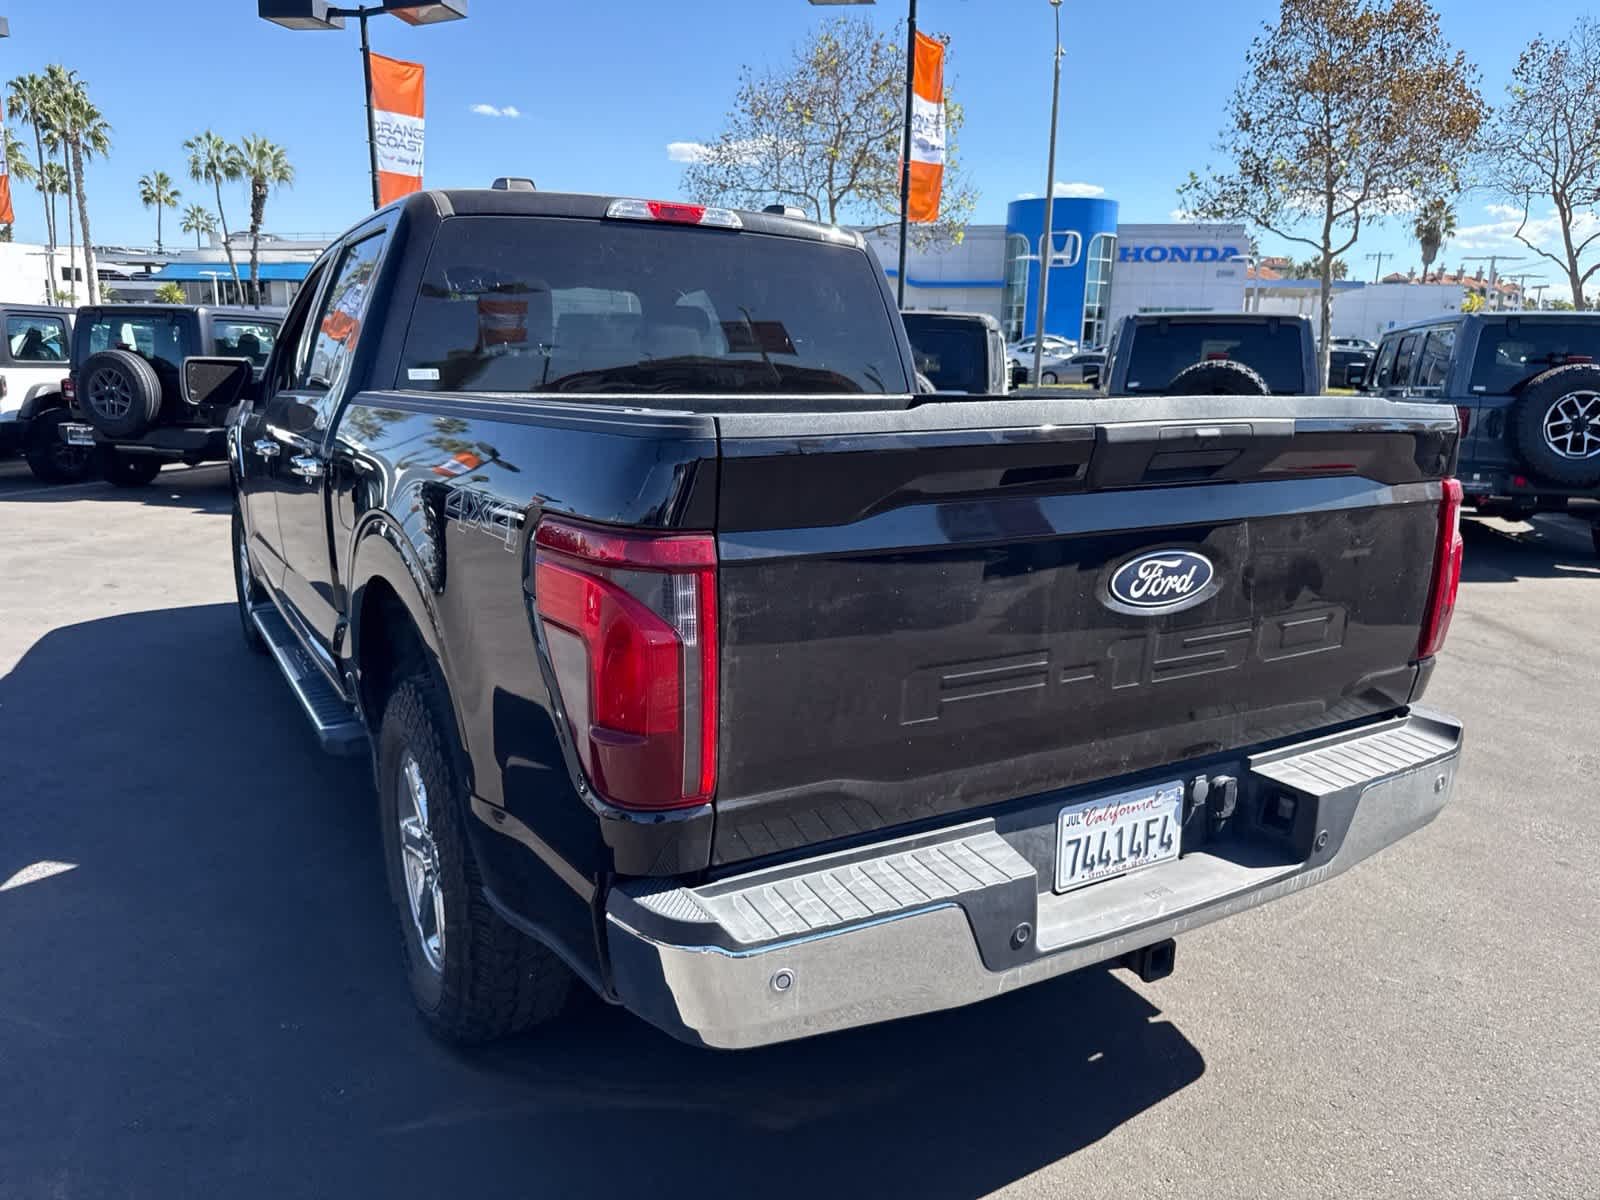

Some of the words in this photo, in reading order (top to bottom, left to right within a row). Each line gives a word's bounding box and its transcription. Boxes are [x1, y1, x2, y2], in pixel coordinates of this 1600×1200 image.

[1118, 246, 1244, 262] HONDA
[1130, 560, 1197, 598] Ford
[1066, 814, 1081, 827] JUL
[1084, 800, 1160, 826] California
[1066, 815, 1172, 880] 74414F4
